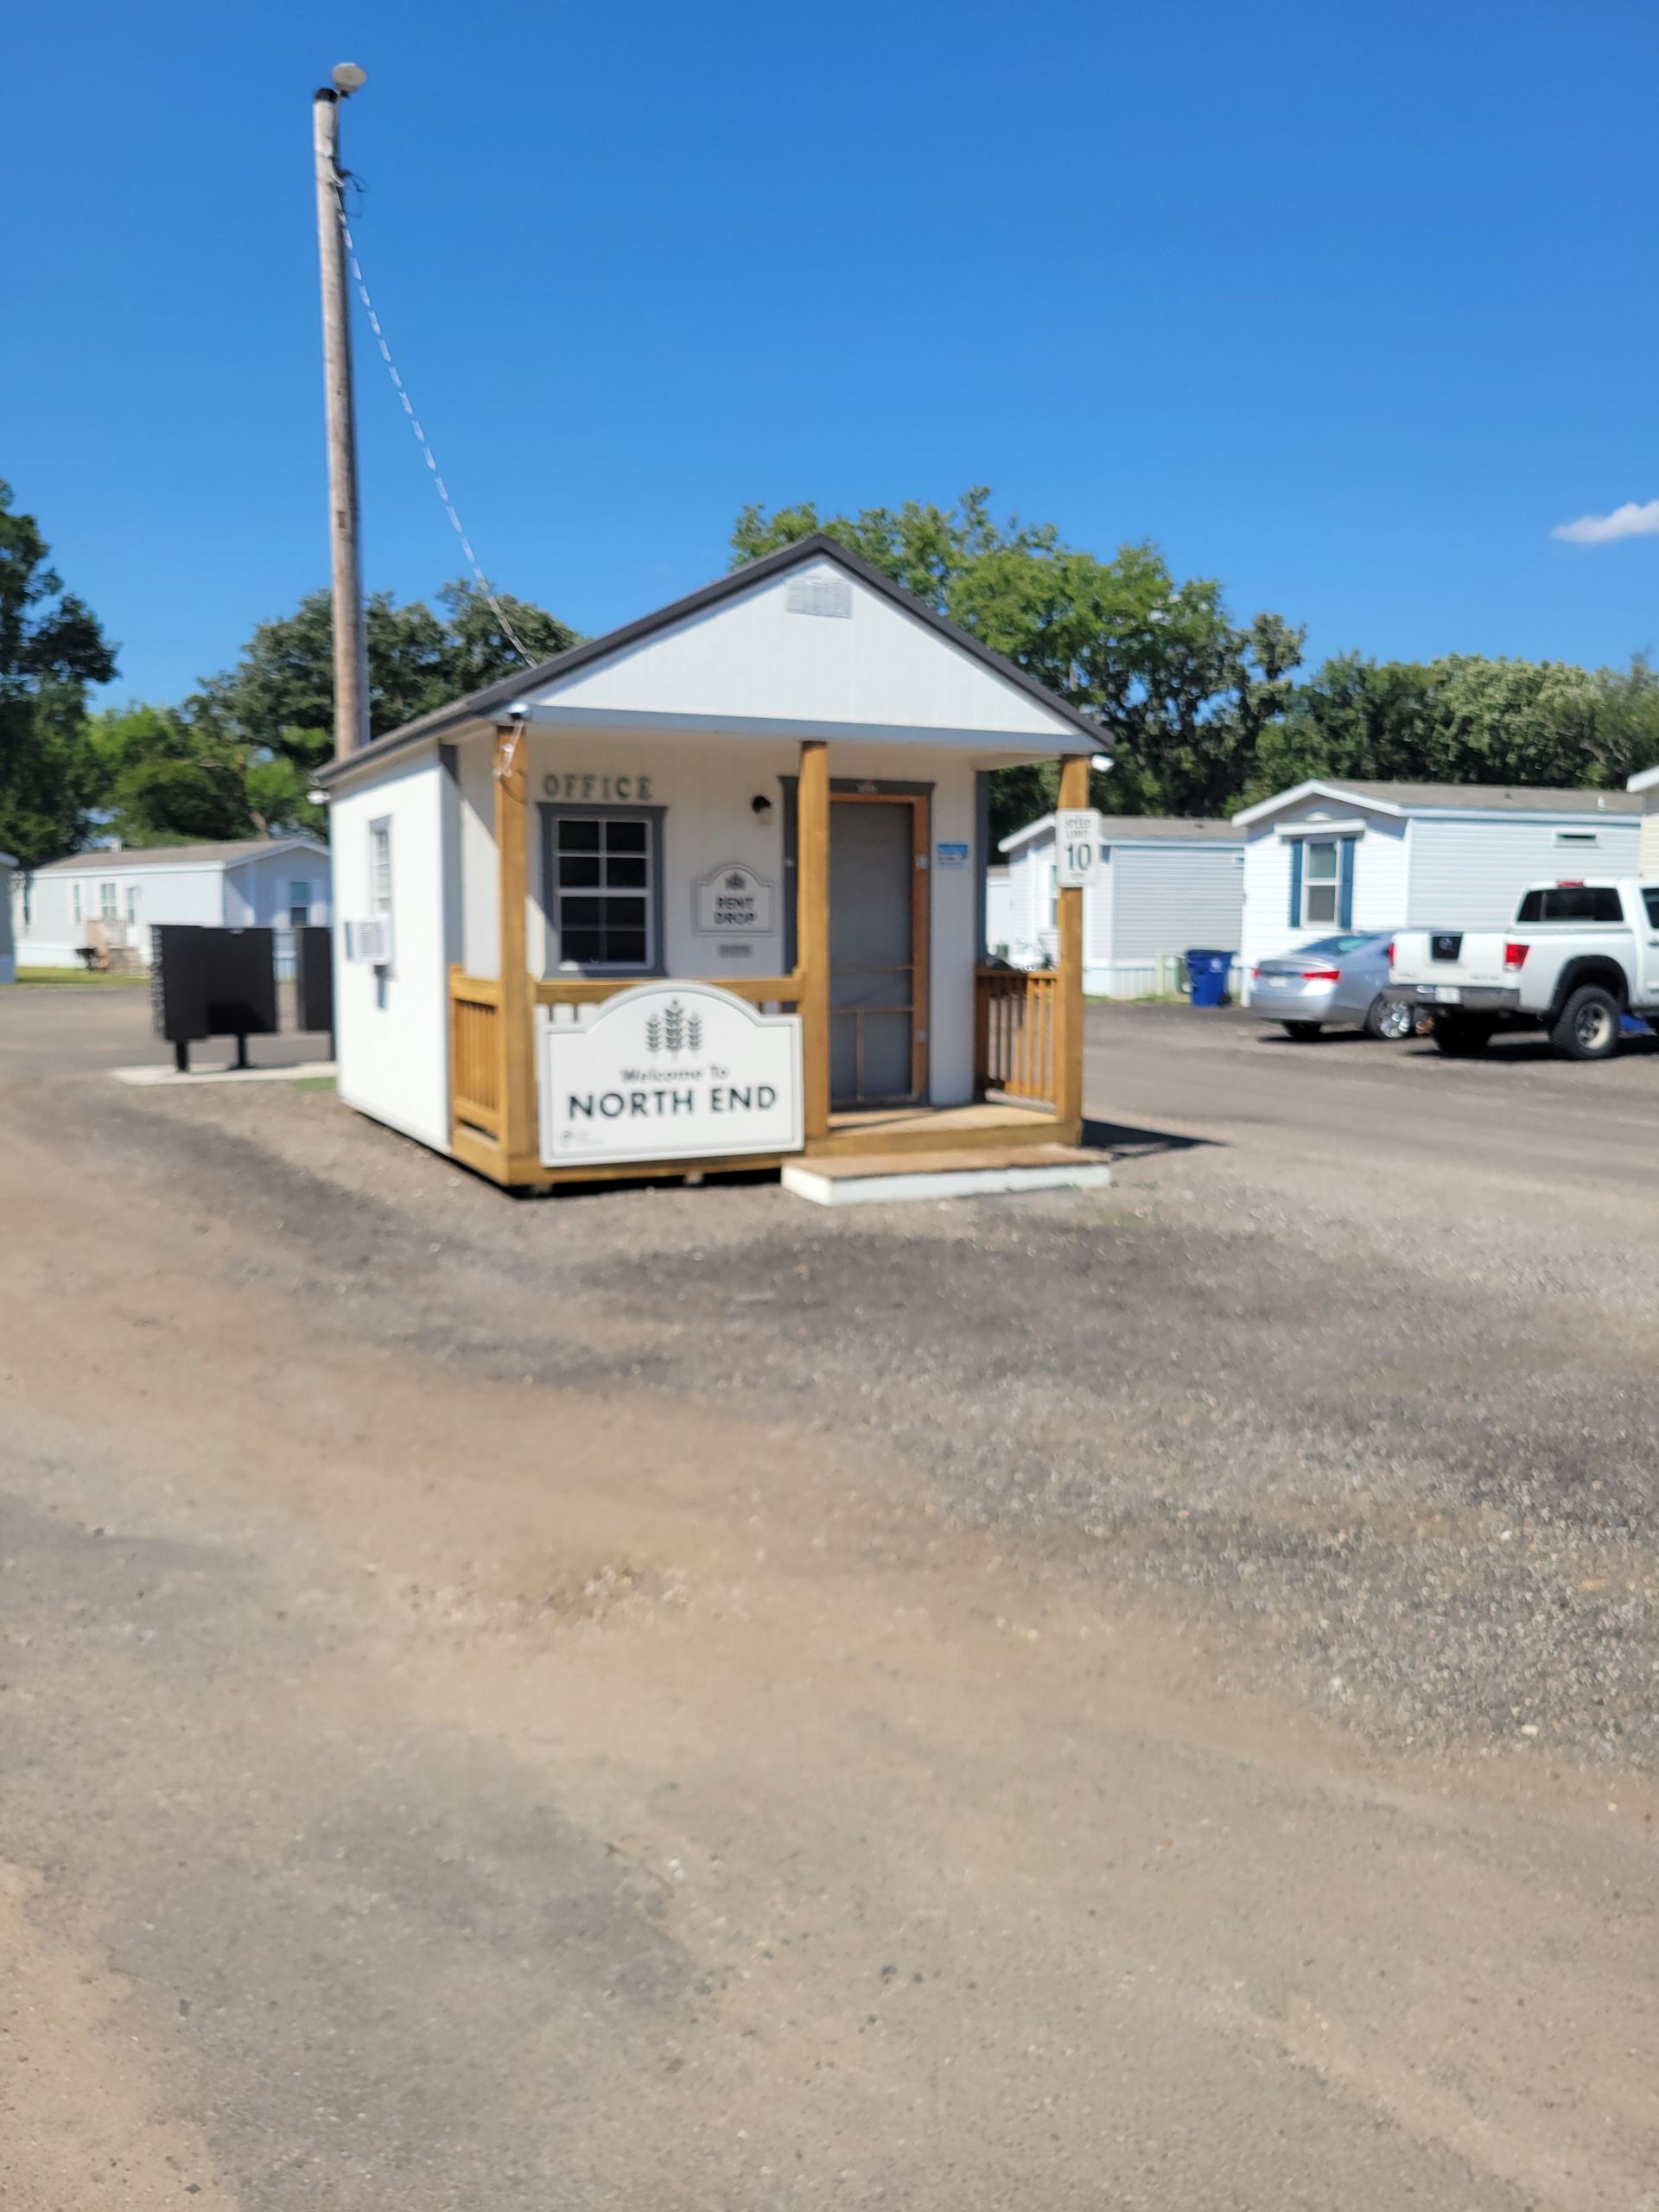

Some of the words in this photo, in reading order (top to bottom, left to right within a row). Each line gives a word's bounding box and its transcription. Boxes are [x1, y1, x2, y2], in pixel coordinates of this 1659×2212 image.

[543, 774, 652, 800] OFFICE
[1065, 843, 1091, 871] 10
[714, 912, 756, 925] DROP
[620, 1066, 702, 1084] Welcome
[569, 1090, 692, 1119] NORTH
[711, 1085, 777, 1113] END
